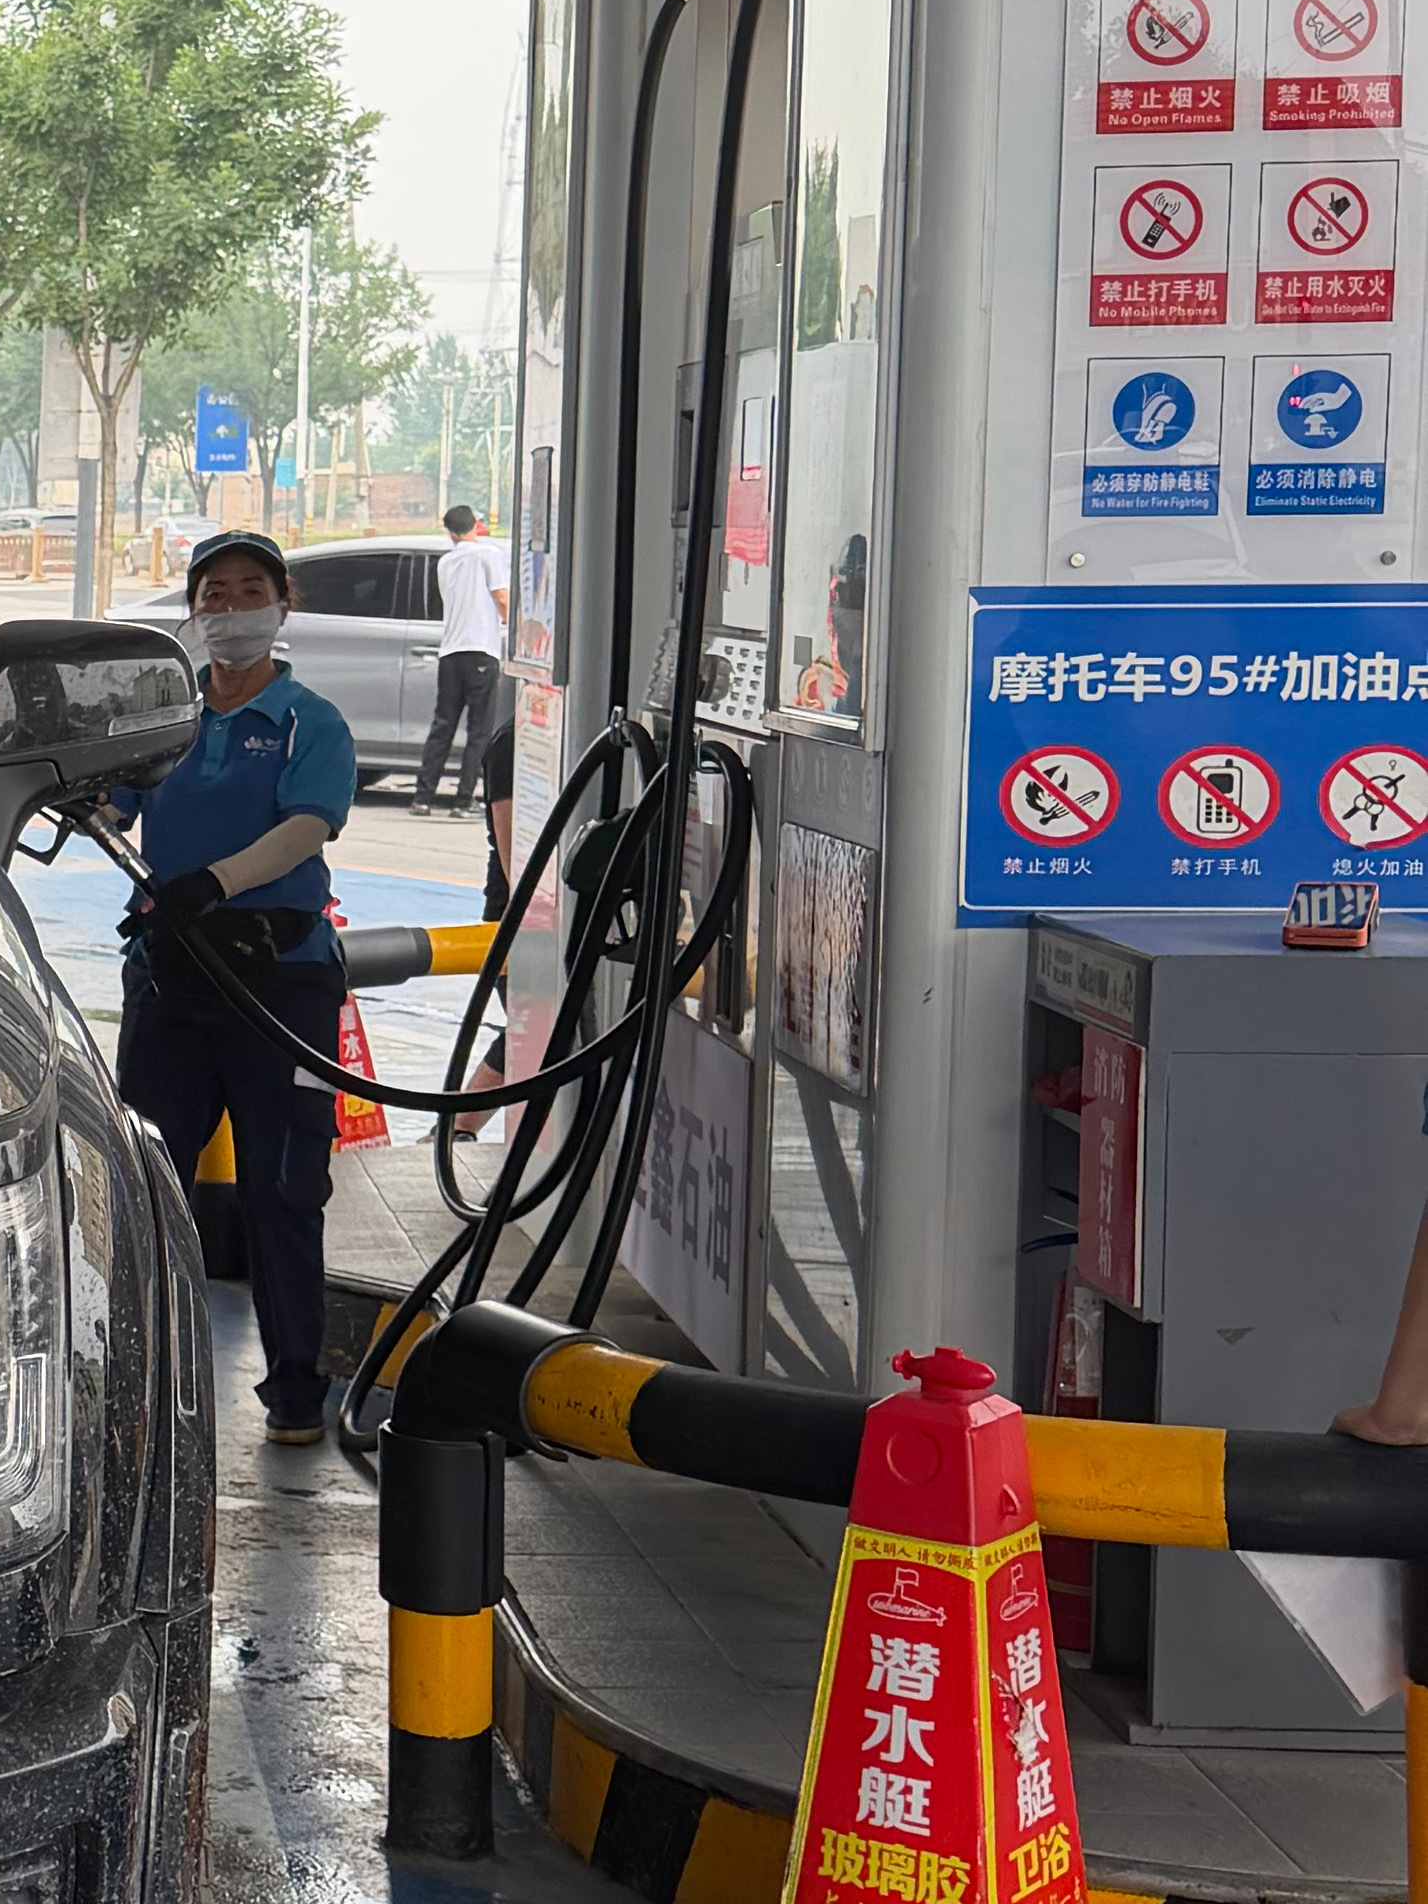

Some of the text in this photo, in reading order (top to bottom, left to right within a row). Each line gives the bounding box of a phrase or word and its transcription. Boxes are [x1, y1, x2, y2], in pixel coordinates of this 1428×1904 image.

[1110, 86, 1222, 110] 禁止烟火
[1277, 81, 1391, 107] 禁止吸烟
[1108, 112, 1223, 127] No Open Flames
[1269, 107, 1396, 123] Smoking Prohibited
[1100, 278, 1219, 303] 禁止打手机
[1264, 275, 1387, 299] 禁止用水灭火
[1098, 304, 1218, 318] No Mobile Phones
[1092, 471, 1211, 493] 必须穿防静电鞋
[1254, 468, 1377, 490] 必须消除静电
[1151, 496, 1169, 507] Fire
[1170, 496, 1210, 511] Fighting
[1255, 495, 1377, 509] Eliminate Static Electricity
[1003, 857, 1093, 876] 禁止烟火
[1171, 857, 1262, 877] 禁打手机
[1332, 858, 1424, 878] 熄火加油
[1094, 1046, 1126, 1105] 消防
[634, 1076, 733, 1295] 鑫石油
[1098, 1116, 1116, 1279] 器材箱
[856, 1633, 941, 1837] 潜水艇
[1008, 1822, 1071, 1904] 卫浴
